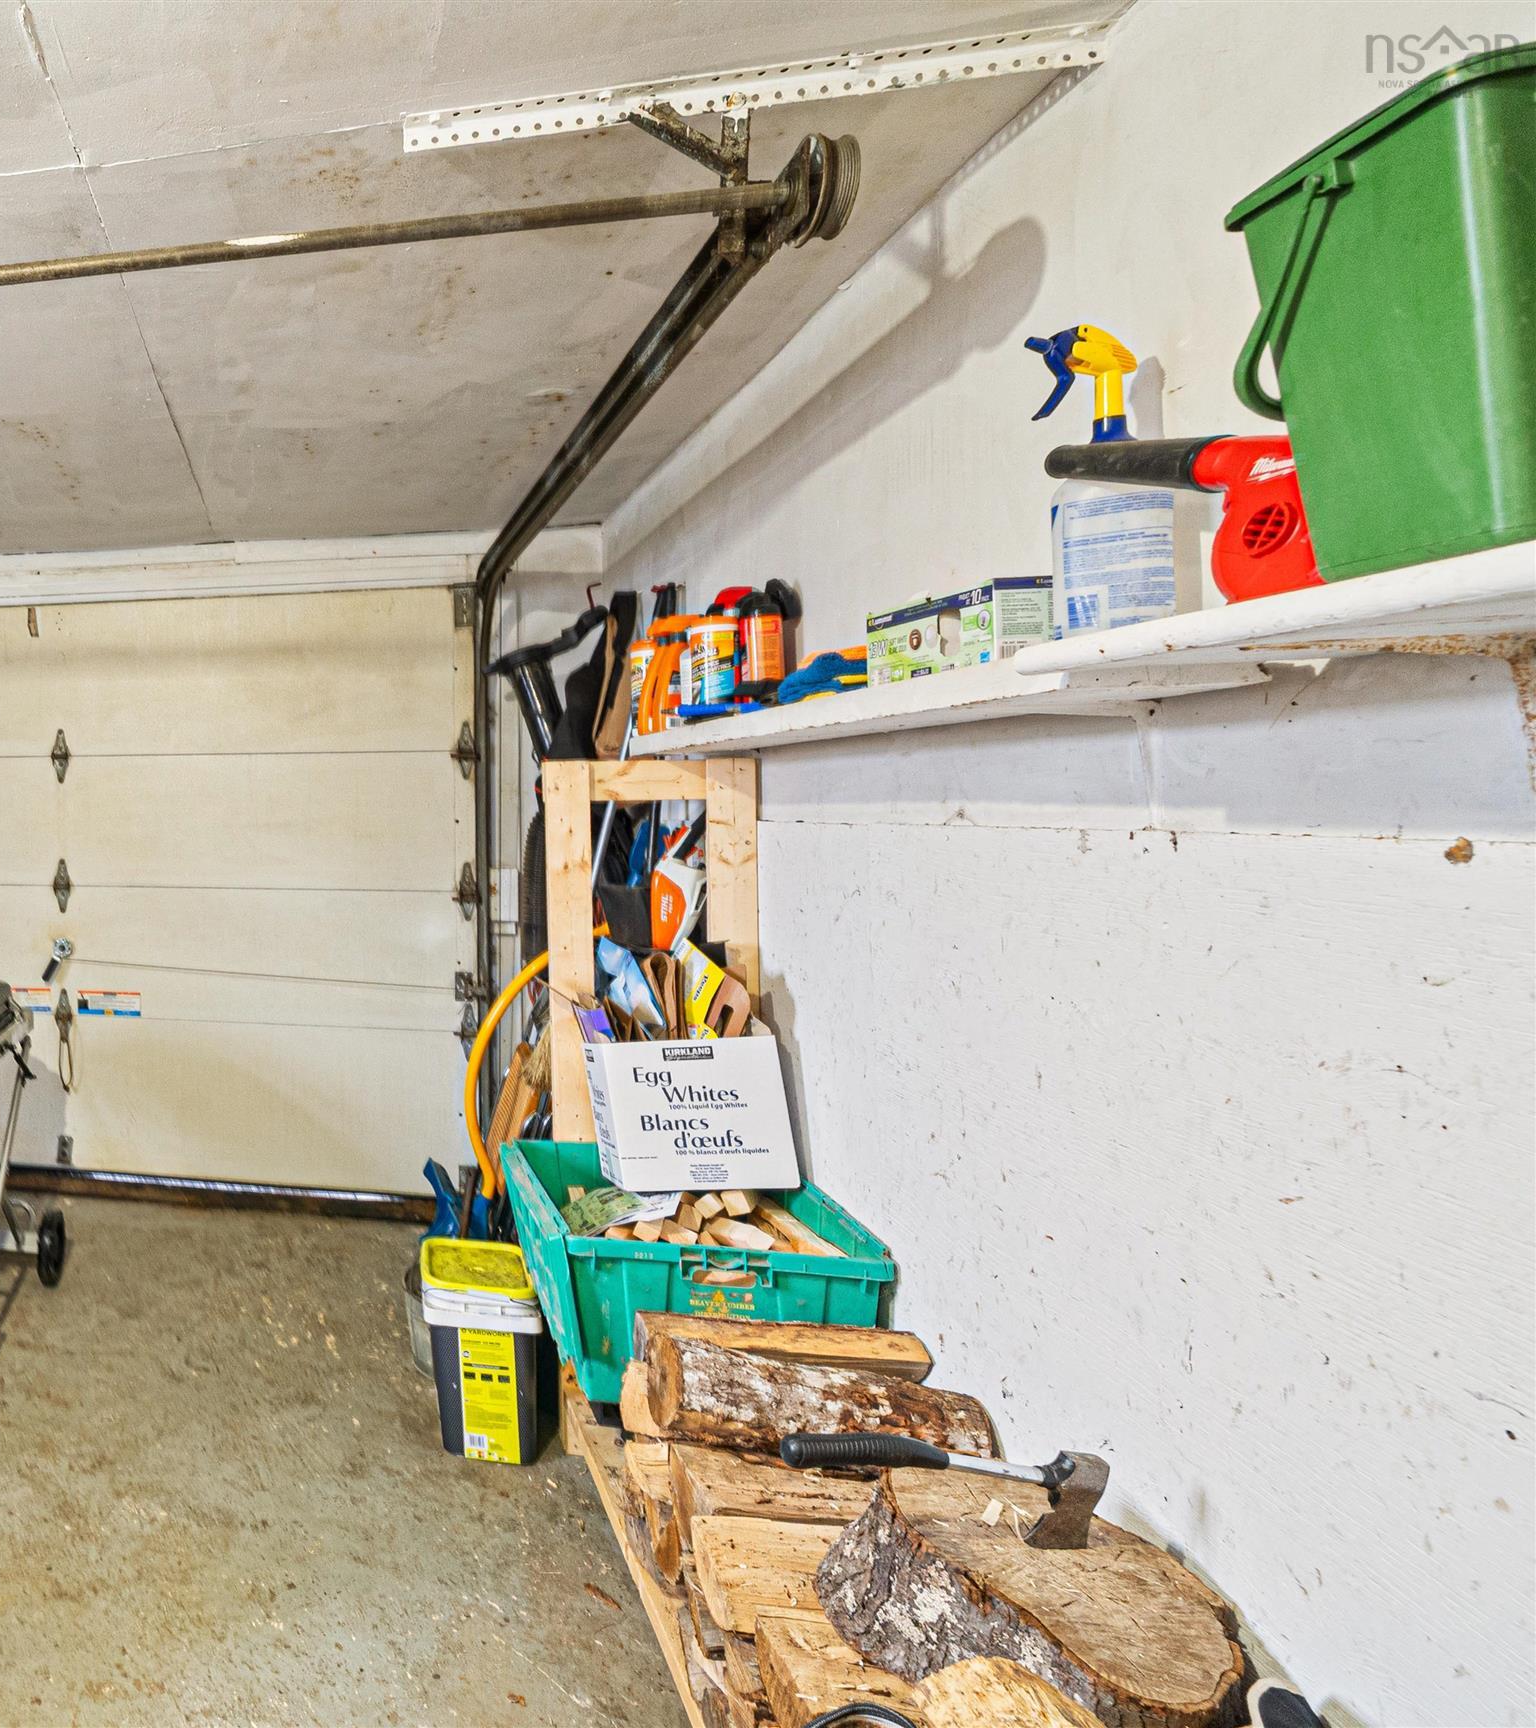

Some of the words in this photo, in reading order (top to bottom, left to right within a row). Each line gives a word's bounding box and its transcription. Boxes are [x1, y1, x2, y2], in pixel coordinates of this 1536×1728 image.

[664, 1047, 712, 1057] KIRKLAND
[632, 1066, 673, 1088] Egg
[662, 1084, 740, 1103] Whites
[640, 1113, 710, 1132] Blancs
[673, 1129, 744, 1149] d'œufs
[742, 1146, 770, 1156] liquides
